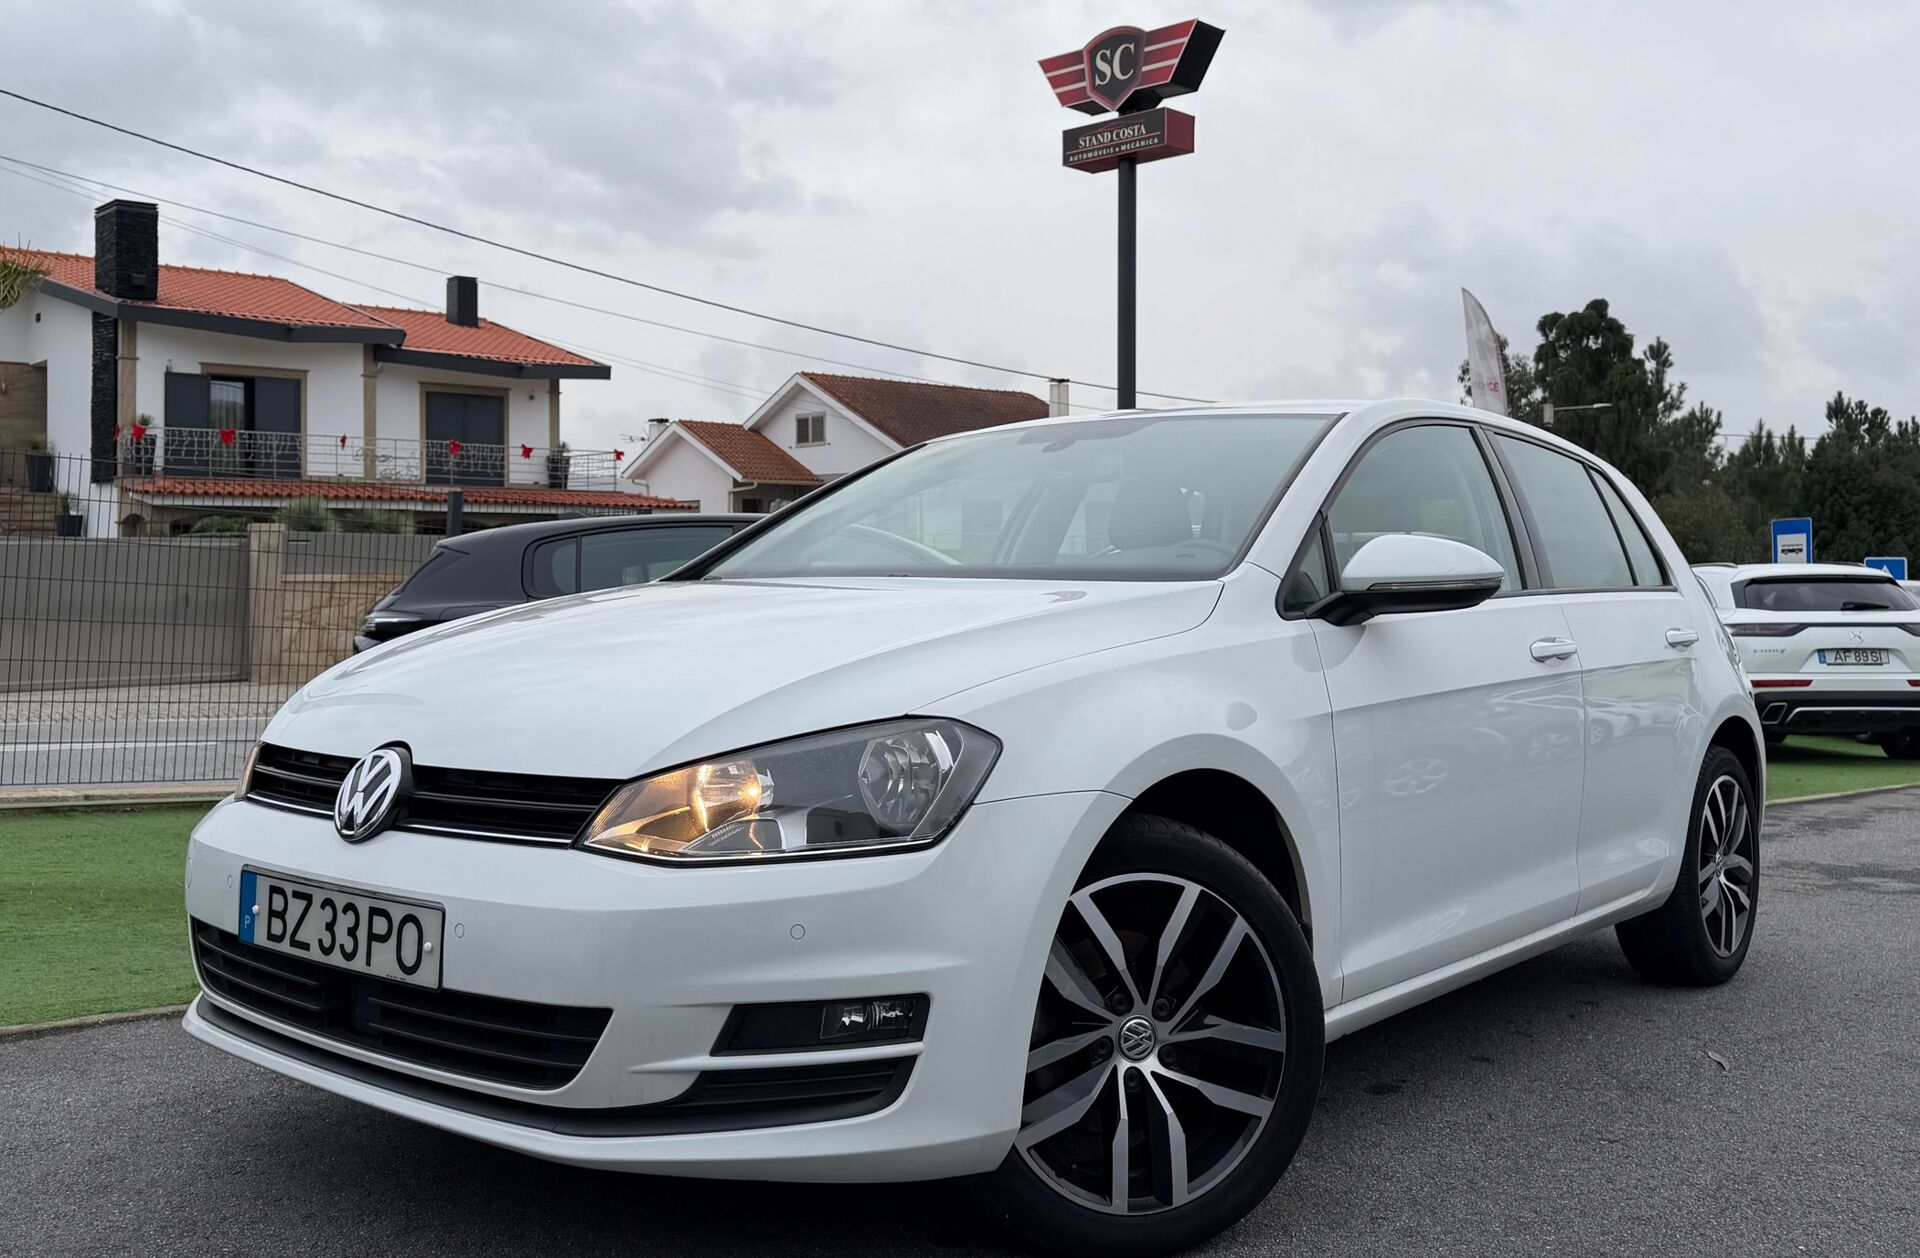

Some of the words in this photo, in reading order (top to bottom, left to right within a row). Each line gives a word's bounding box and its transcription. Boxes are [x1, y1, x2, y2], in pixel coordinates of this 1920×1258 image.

[1095, 42, 1135, 86] SC
[1079, 131, 1111, 148] STAND
[1113, 124, 1146, 141] COSTA
[1069, 147, 1114, 162] AUTOMÓVEIS
[244, 914, 251, 929] P
